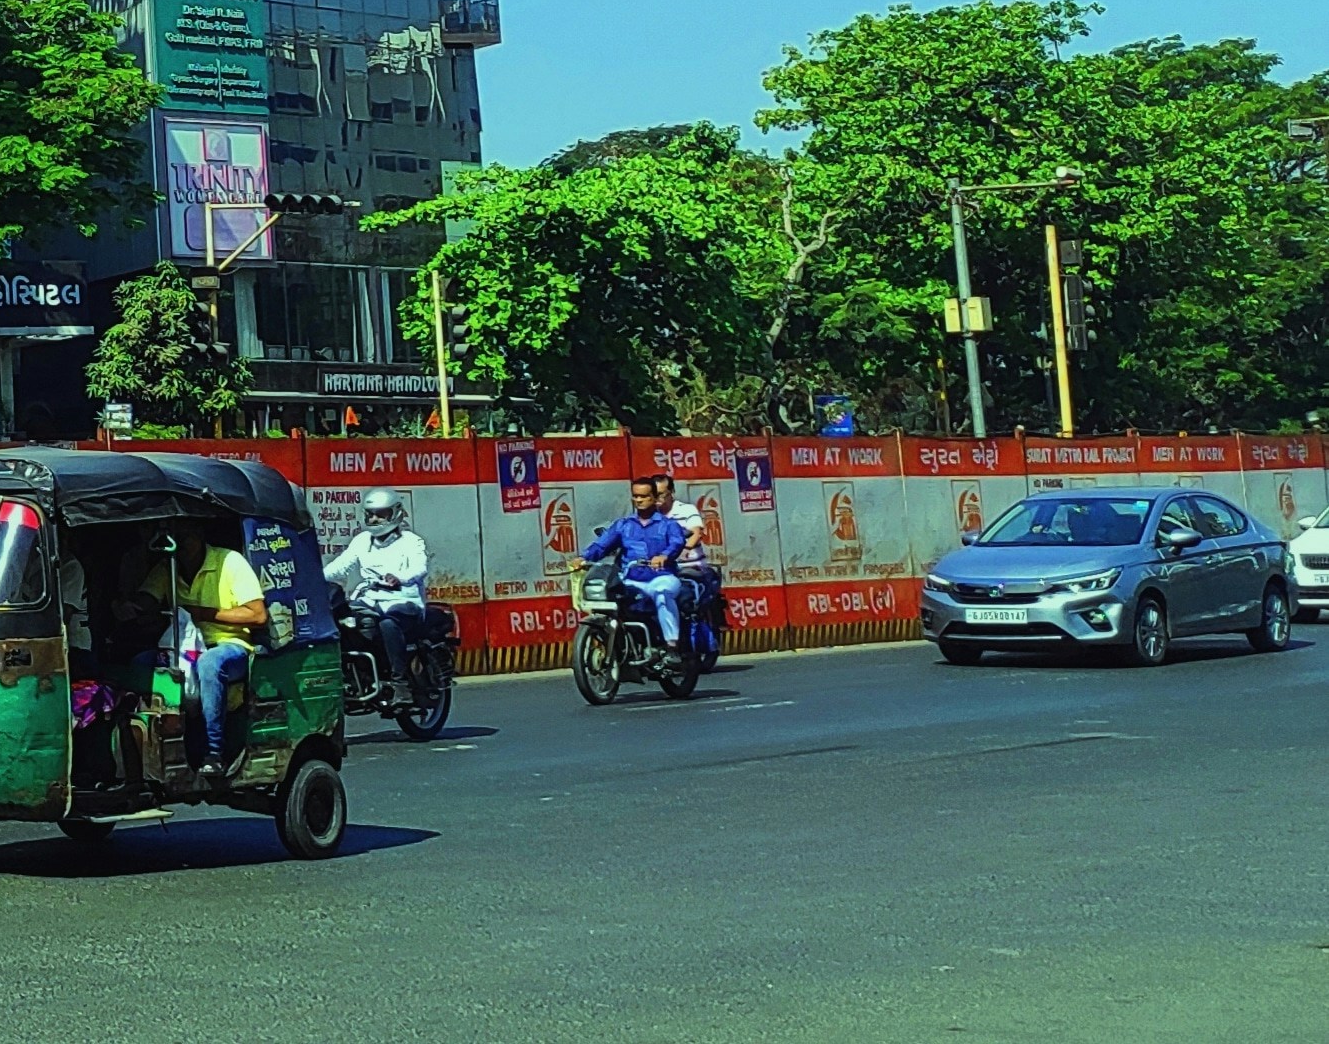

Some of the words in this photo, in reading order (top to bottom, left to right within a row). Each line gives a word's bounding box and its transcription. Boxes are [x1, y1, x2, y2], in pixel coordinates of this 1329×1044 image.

[170, 162, 262, 194] TRINITY
[324, 373, 384, 393] HARYANA
[329, 451, 367, 473] MEN
[371, 452, 399, 473] AT
[405, 451, 453, 473] WORK
[536, 448, 554, 470] AT
[562, 448, 604, 469] WORK
[791, 447, 819, 467] MEN
[823, 446, 842, 466] AT
[847, 446, 883, 466] WORK
[1152, 446, 1175, 463] MEN
[1179, 446, 1194, 463] AT
[1197, 446, 1226, 463] WORK
[312, 490, 324, 504] NO
[325, 490, 361, 504] PARKING
[494, 581, 528, 596] METRO
[534, 579, 563, 594] WORK
[728, 596, 770, 627] સુરત
